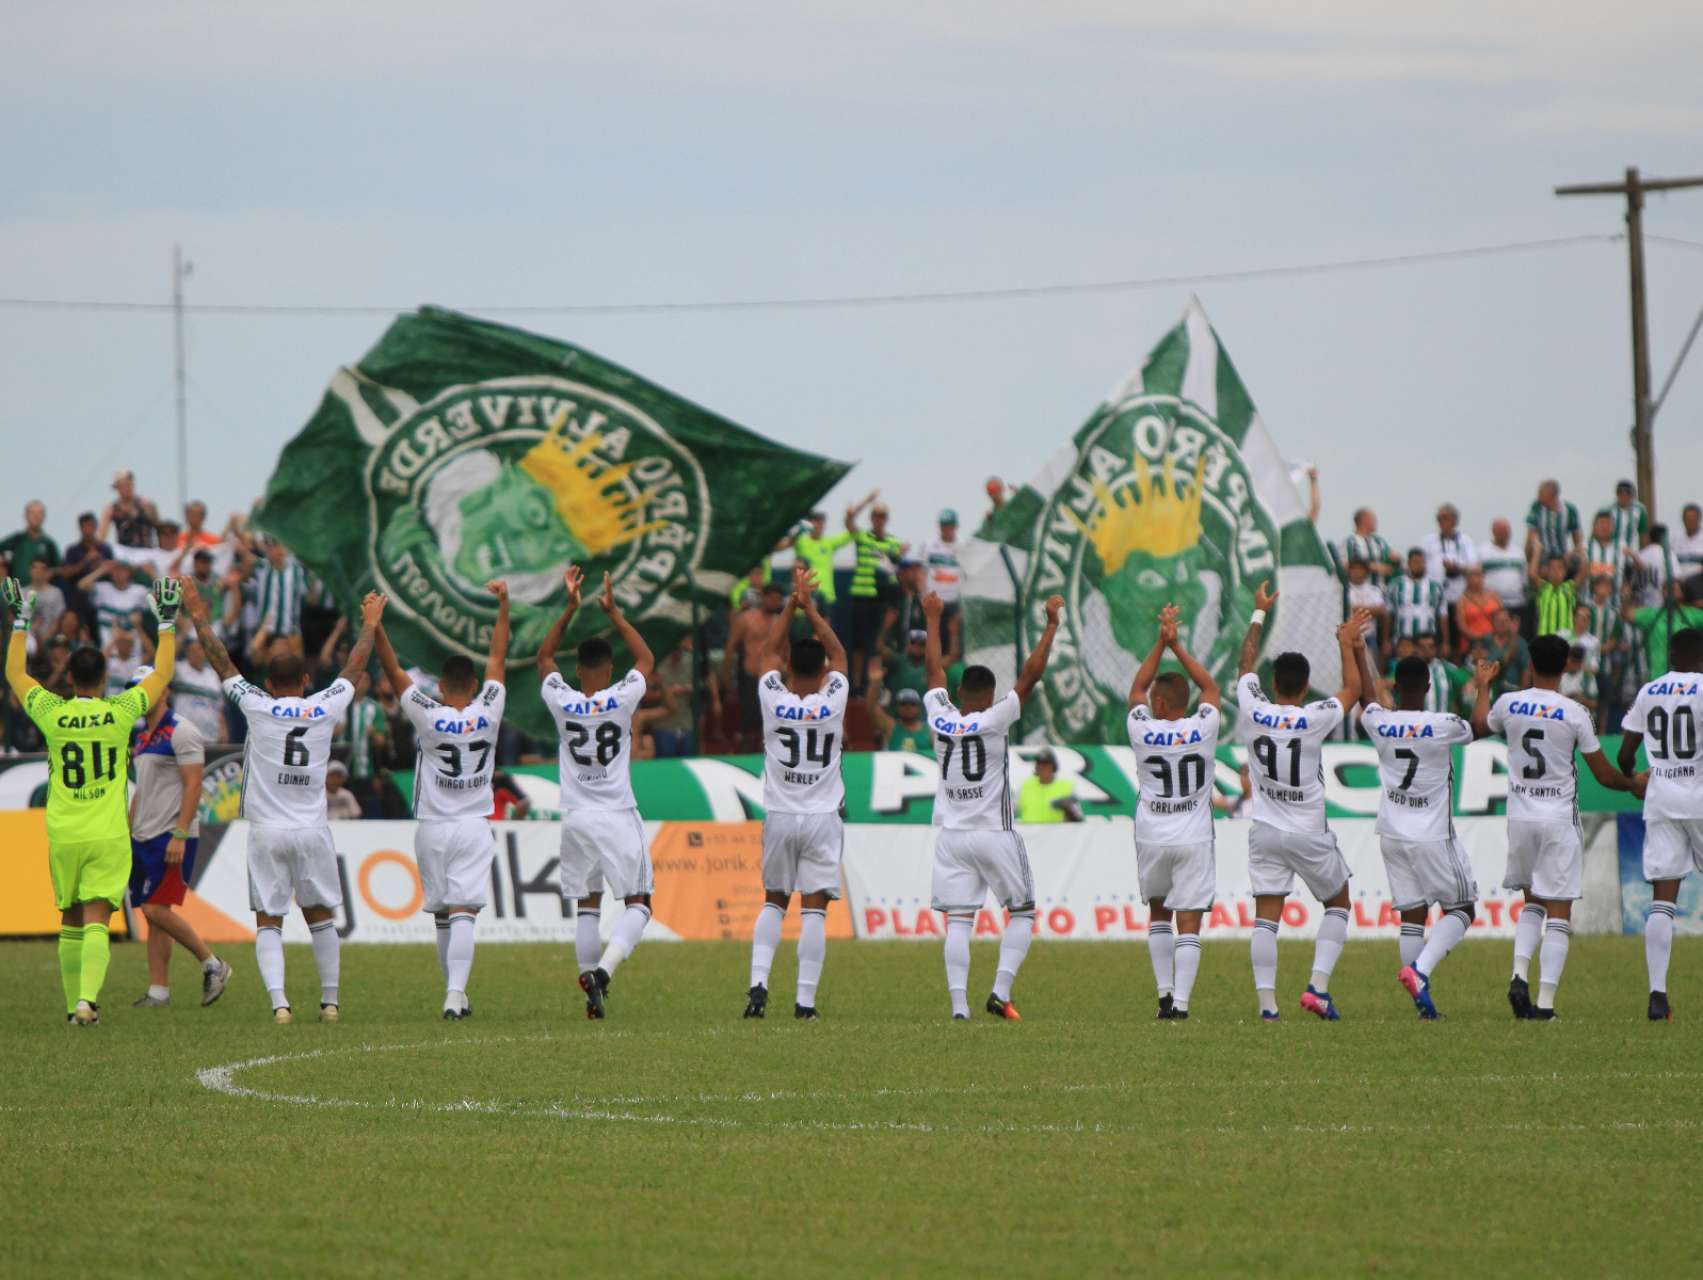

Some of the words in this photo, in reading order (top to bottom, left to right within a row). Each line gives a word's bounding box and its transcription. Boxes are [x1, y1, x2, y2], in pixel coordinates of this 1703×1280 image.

[1648, 682, 1698, 696] CAIXA
[271, 705, 326, 720] CAIXA
[563, 696, 619, 715] CAIXA
[775, 704, 832, 721] CAIXA
[1509, 701, 1564, 721] CAIXA
[57, 712, 115, 729] CAIXA
[434, 714, 489, 735] CAIXA
[934, 717, 979, 737] CAIXA
[1252, 711, 1308, 731] CAIXA
[1143, 729, 1202, 747] CAIXA
[1377, 724, 1434, 739] CAIXA
[1647, 705, 1697, 760] 90
[283, 726, 310, 767] 6
[565, 720, 622, 767] 28
[773, 726, 835, 769] 34
[435, 739, 491, 778] 37
[937, 734, 986, 782] 70
[1253, 735, 1302, 787] 91
[1522, 729, 1546, 779] 5
[61, 741, 117, 789] 84
[1394, 748, 1420, 791] 7
[278, 773, 310, 786] EDINHO
[435, 775, 465, 789] THIAGO
[467, 775, 489, 789] LOPE
[1143, 753, 1206, 799] 30
[73, 788, 106, 800] WILSON
[958, 787, 985, 799] SASSE
[1388, 790, 1406, 805] AGO
[1409, 796, 1430, 808] DIAS
[335, 828, 573, 938] joik
